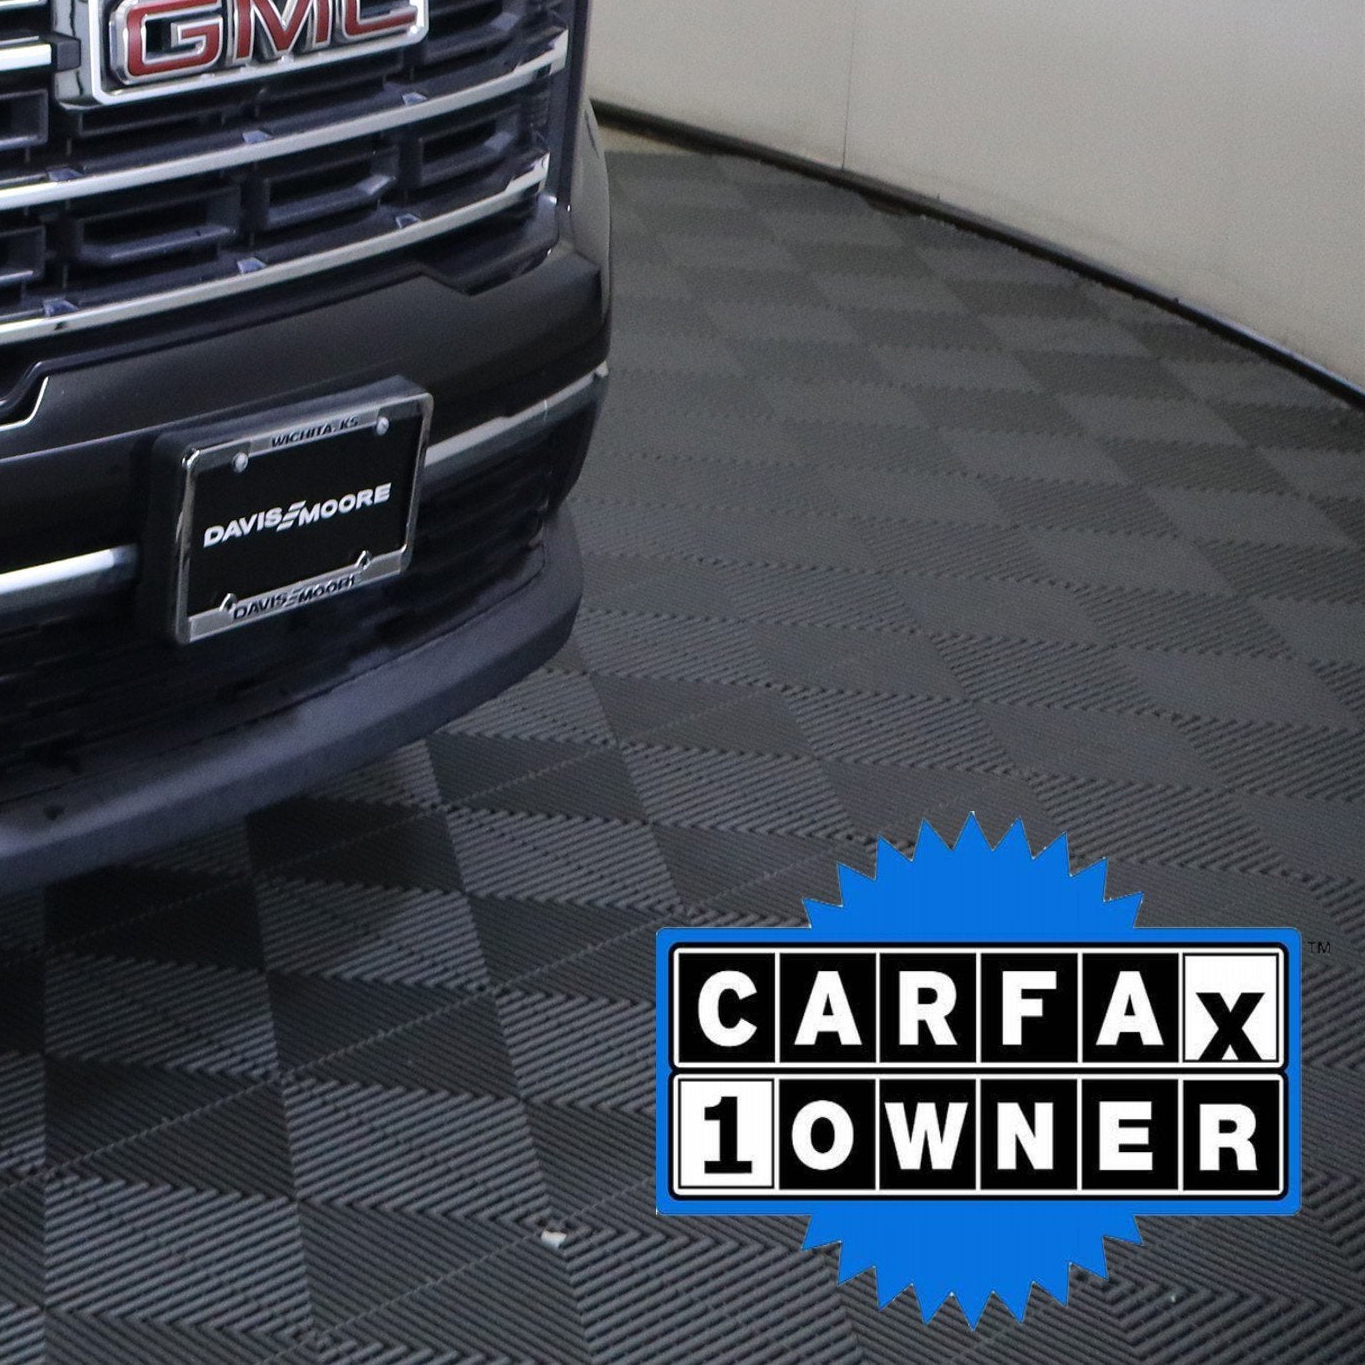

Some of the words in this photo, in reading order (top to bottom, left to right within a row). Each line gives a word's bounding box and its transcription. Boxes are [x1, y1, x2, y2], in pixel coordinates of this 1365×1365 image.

[203, 507, 283, 548] DAVIS
[297, 482, 392, 527] MOORE
[232, 591, 288, 620] DAVIS
